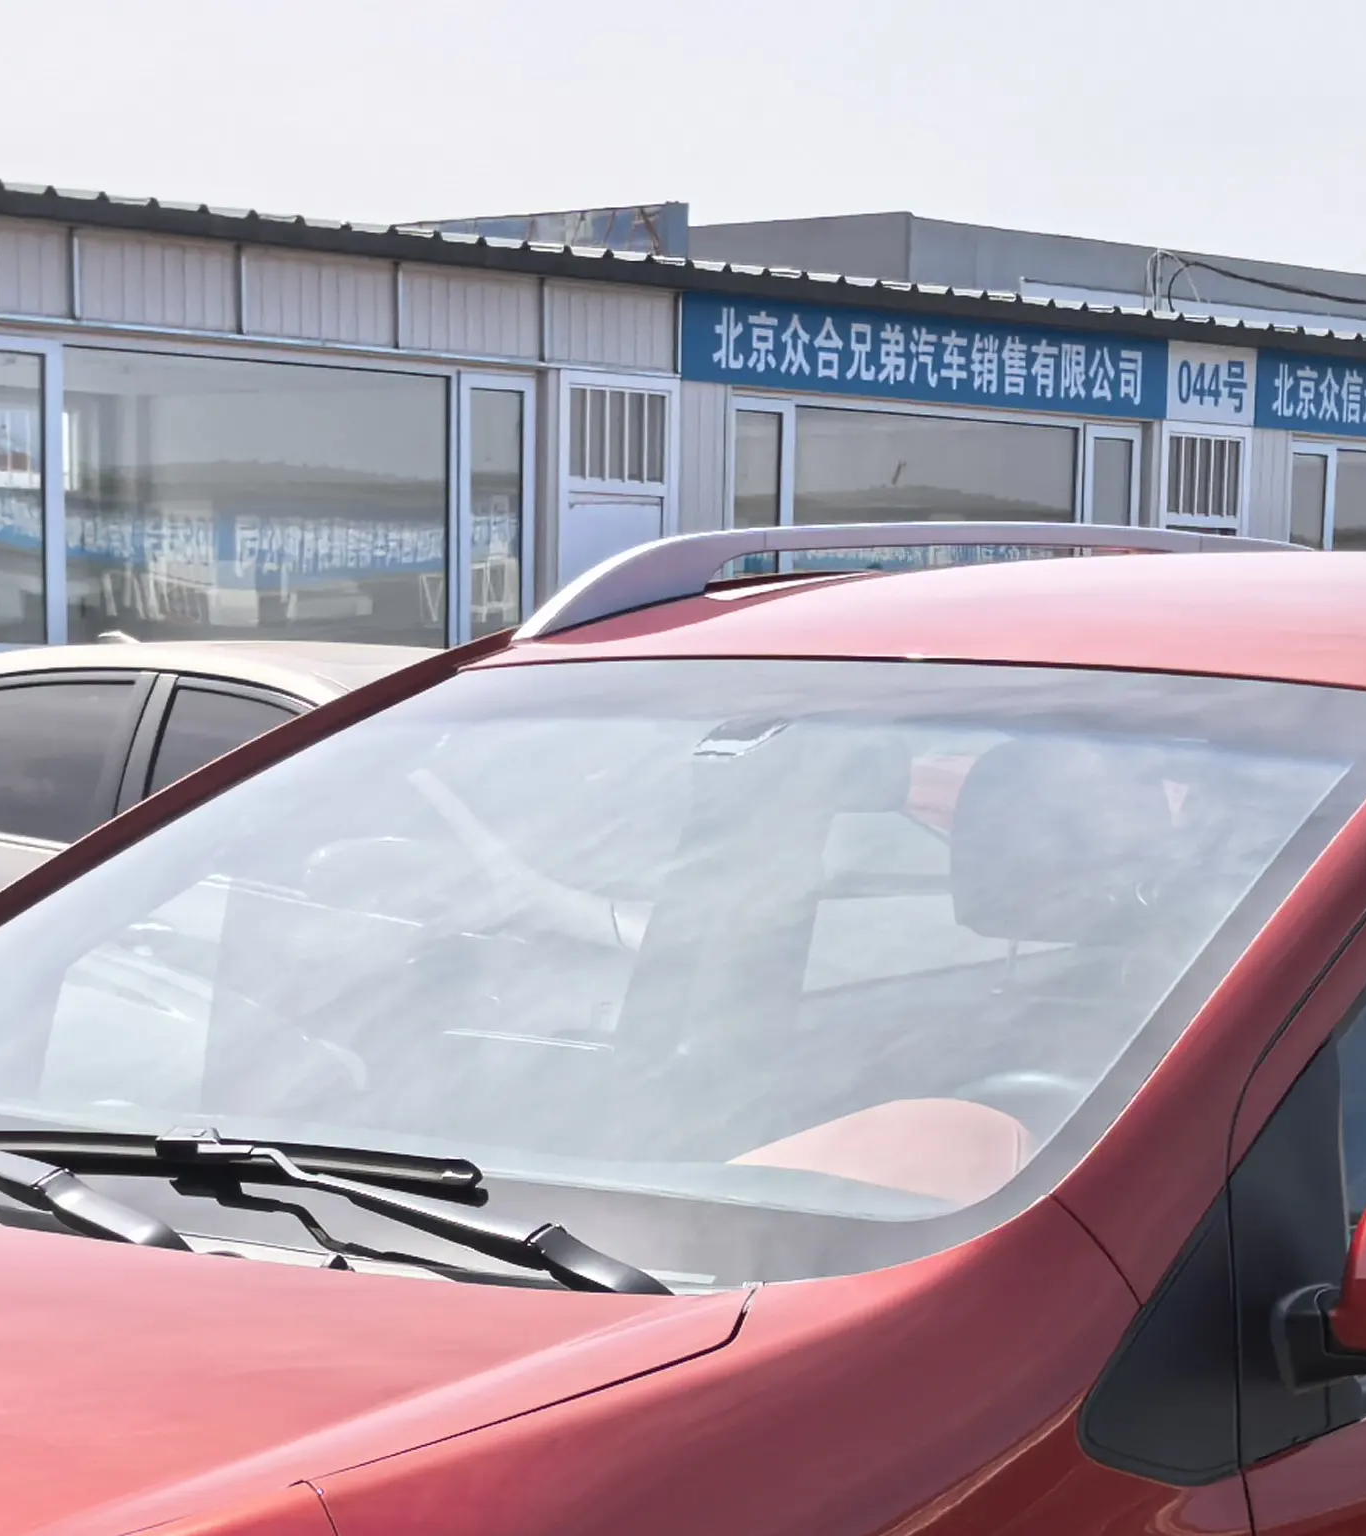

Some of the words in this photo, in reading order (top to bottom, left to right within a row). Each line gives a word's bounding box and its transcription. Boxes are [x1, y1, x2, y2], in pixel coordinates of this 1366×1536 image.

[712, 305, 1144, 407] 北京众合兄弟汽车销售有限公司
[1177, 359, 1248, 414] 044号
